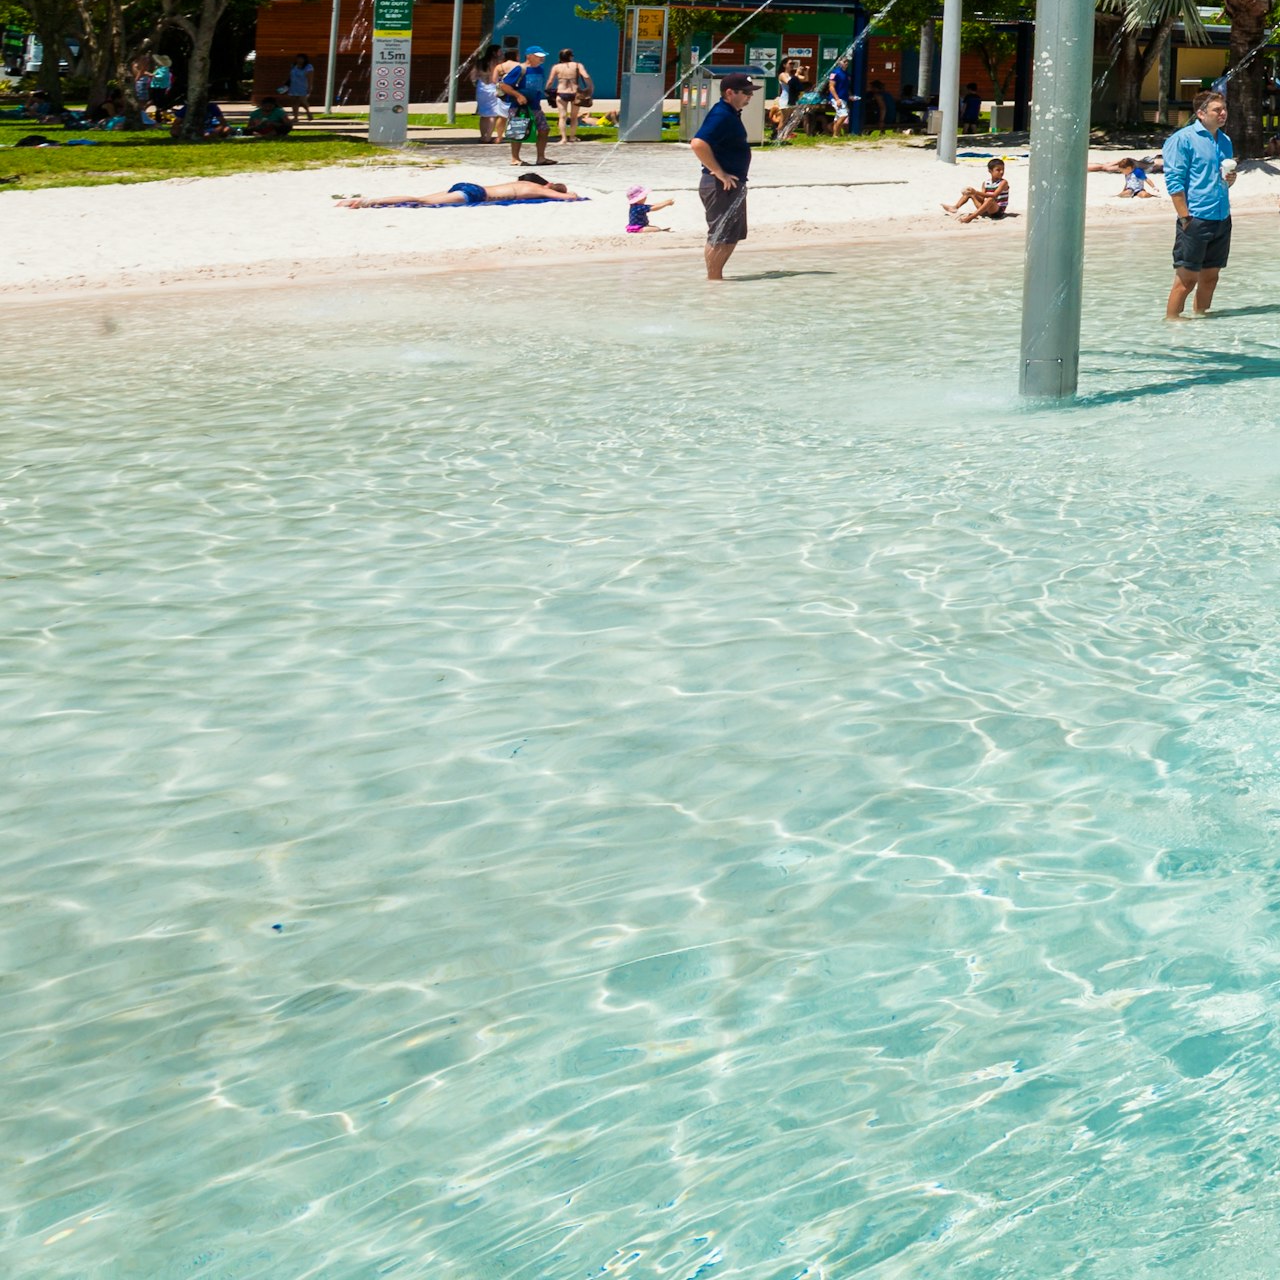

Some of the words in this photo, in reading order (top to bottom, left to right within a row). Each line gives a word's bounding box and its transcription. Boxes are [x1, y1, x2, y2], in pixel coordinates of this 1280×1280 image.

[638, 15, 650, 23] 32
[638, 28, 649, 37] 25
[379, 50, 406, 60] 1.5m
